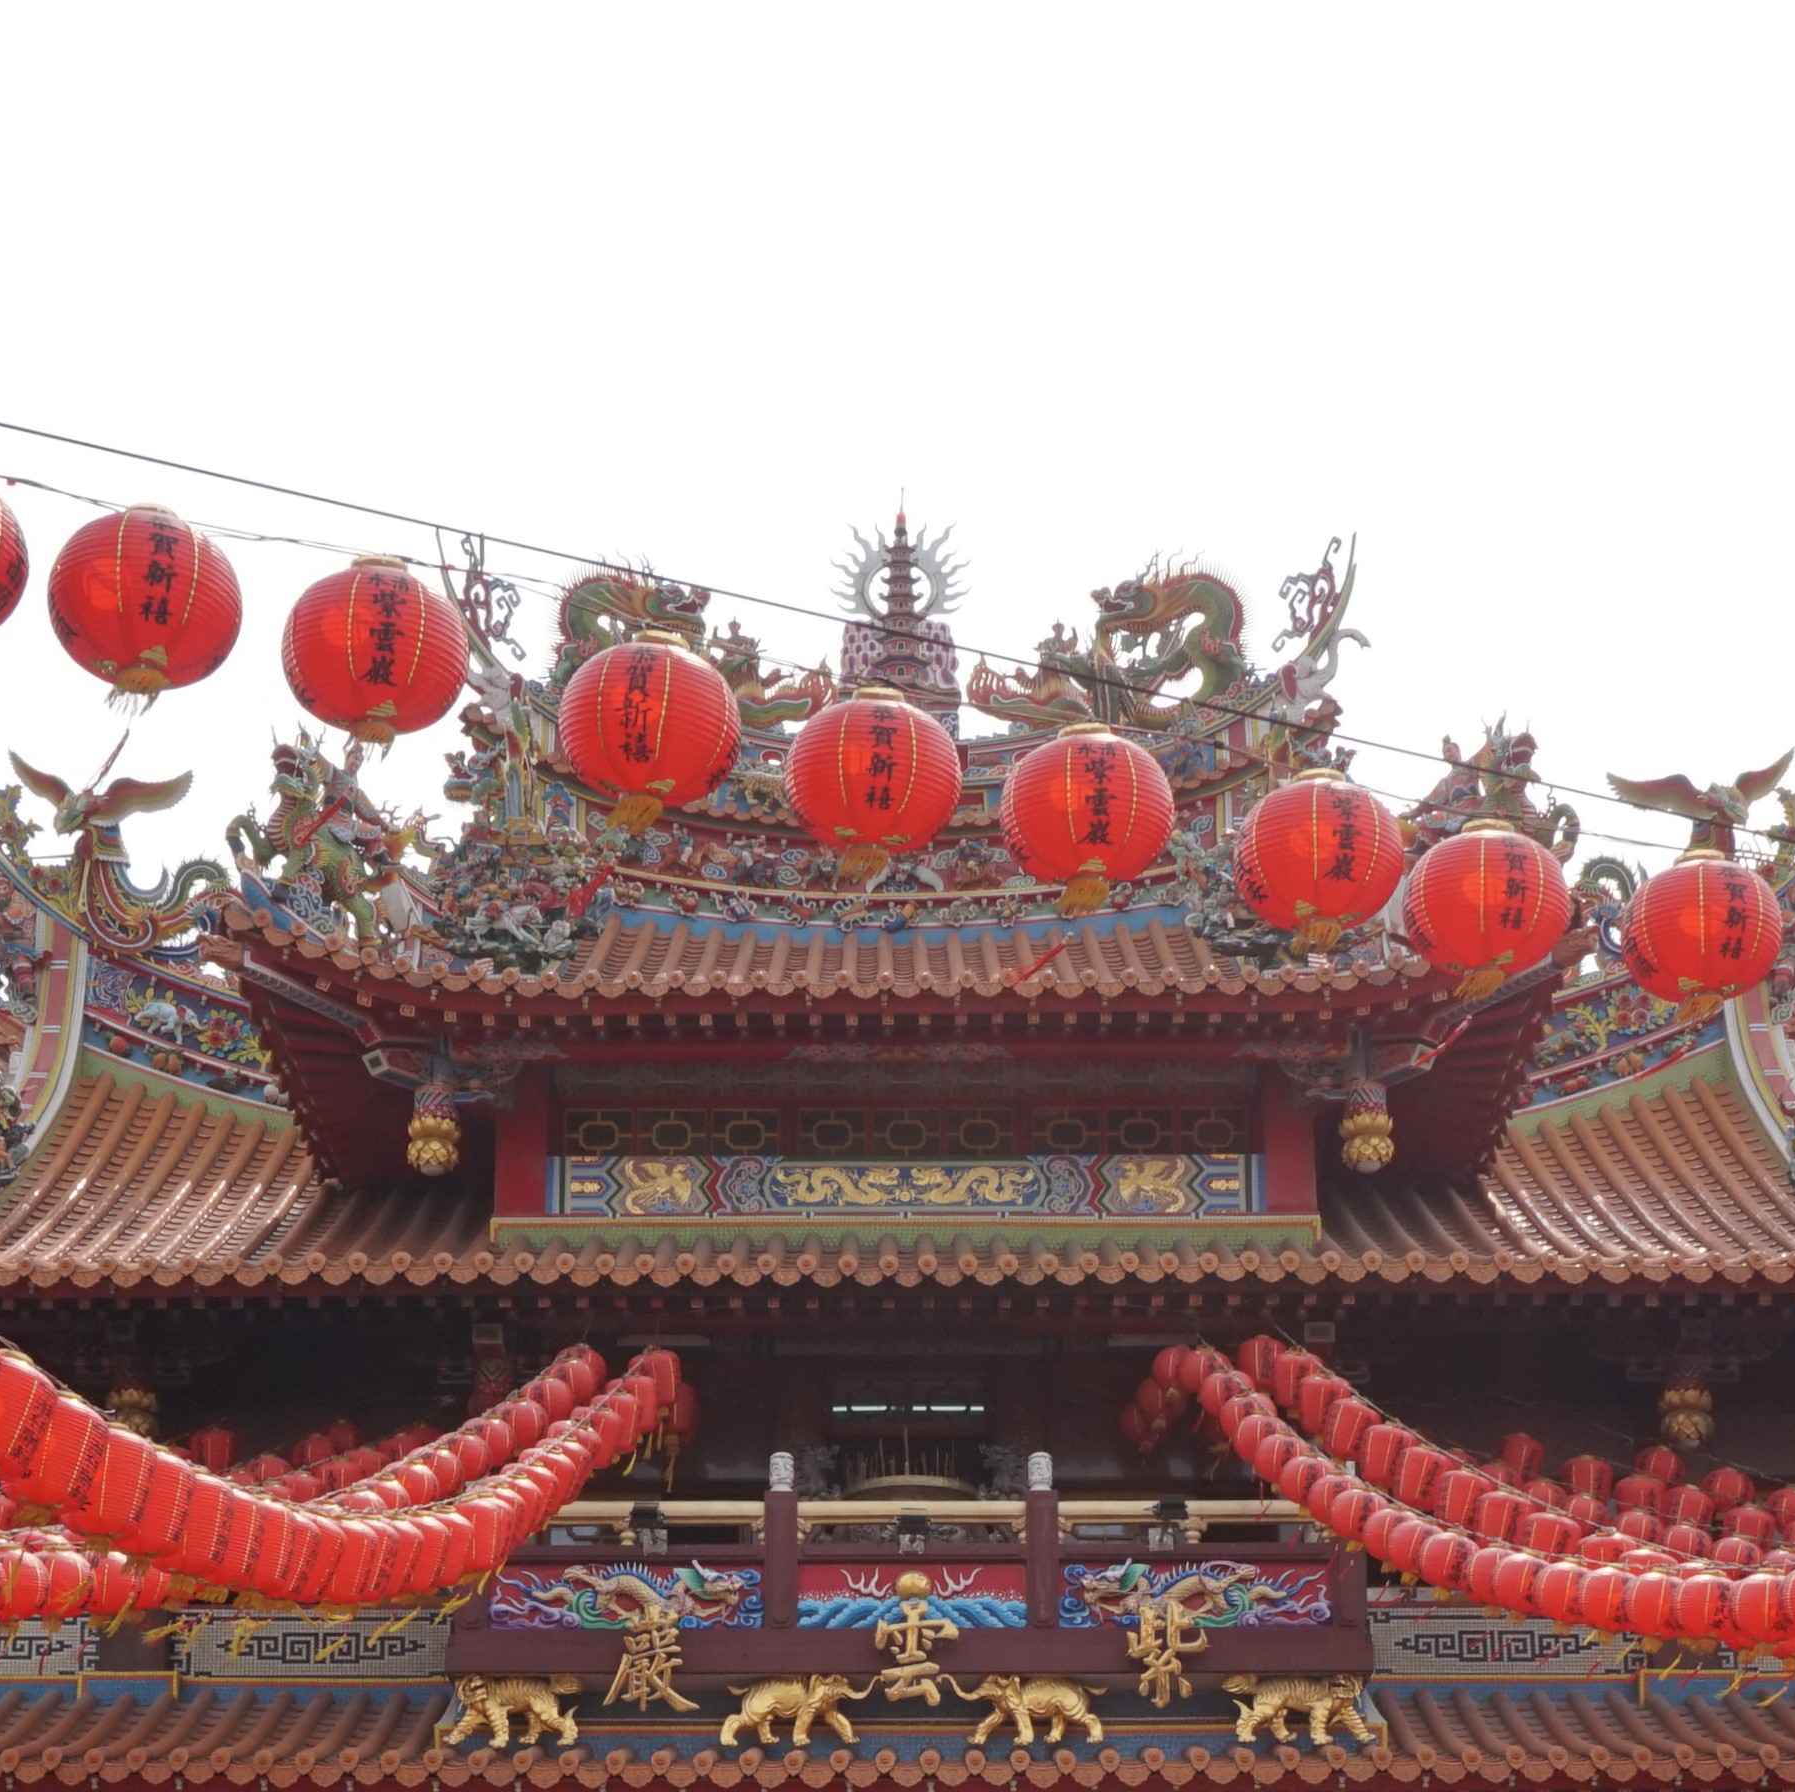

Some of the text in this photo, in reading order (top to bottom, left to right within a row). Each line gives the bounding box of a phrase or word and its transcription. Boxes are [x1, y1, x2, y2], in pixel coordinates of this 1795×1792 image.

[141, 522, 179, 626] 恭賀新禧
[363, 588, 408, 687] 紫雲巖
[615, 646, 656, 762] 恭賀新禧
[866, 707, 897, 810] 恭賀新禧
[1085, 756, 1115, 845] 紫雲巖
[1321, 794, 1365, 885] 紫雲巖
[1501, 836, 1531, 929] 恭賀新禧
[1716, 866, 1752, 962] 恭賀新禧
